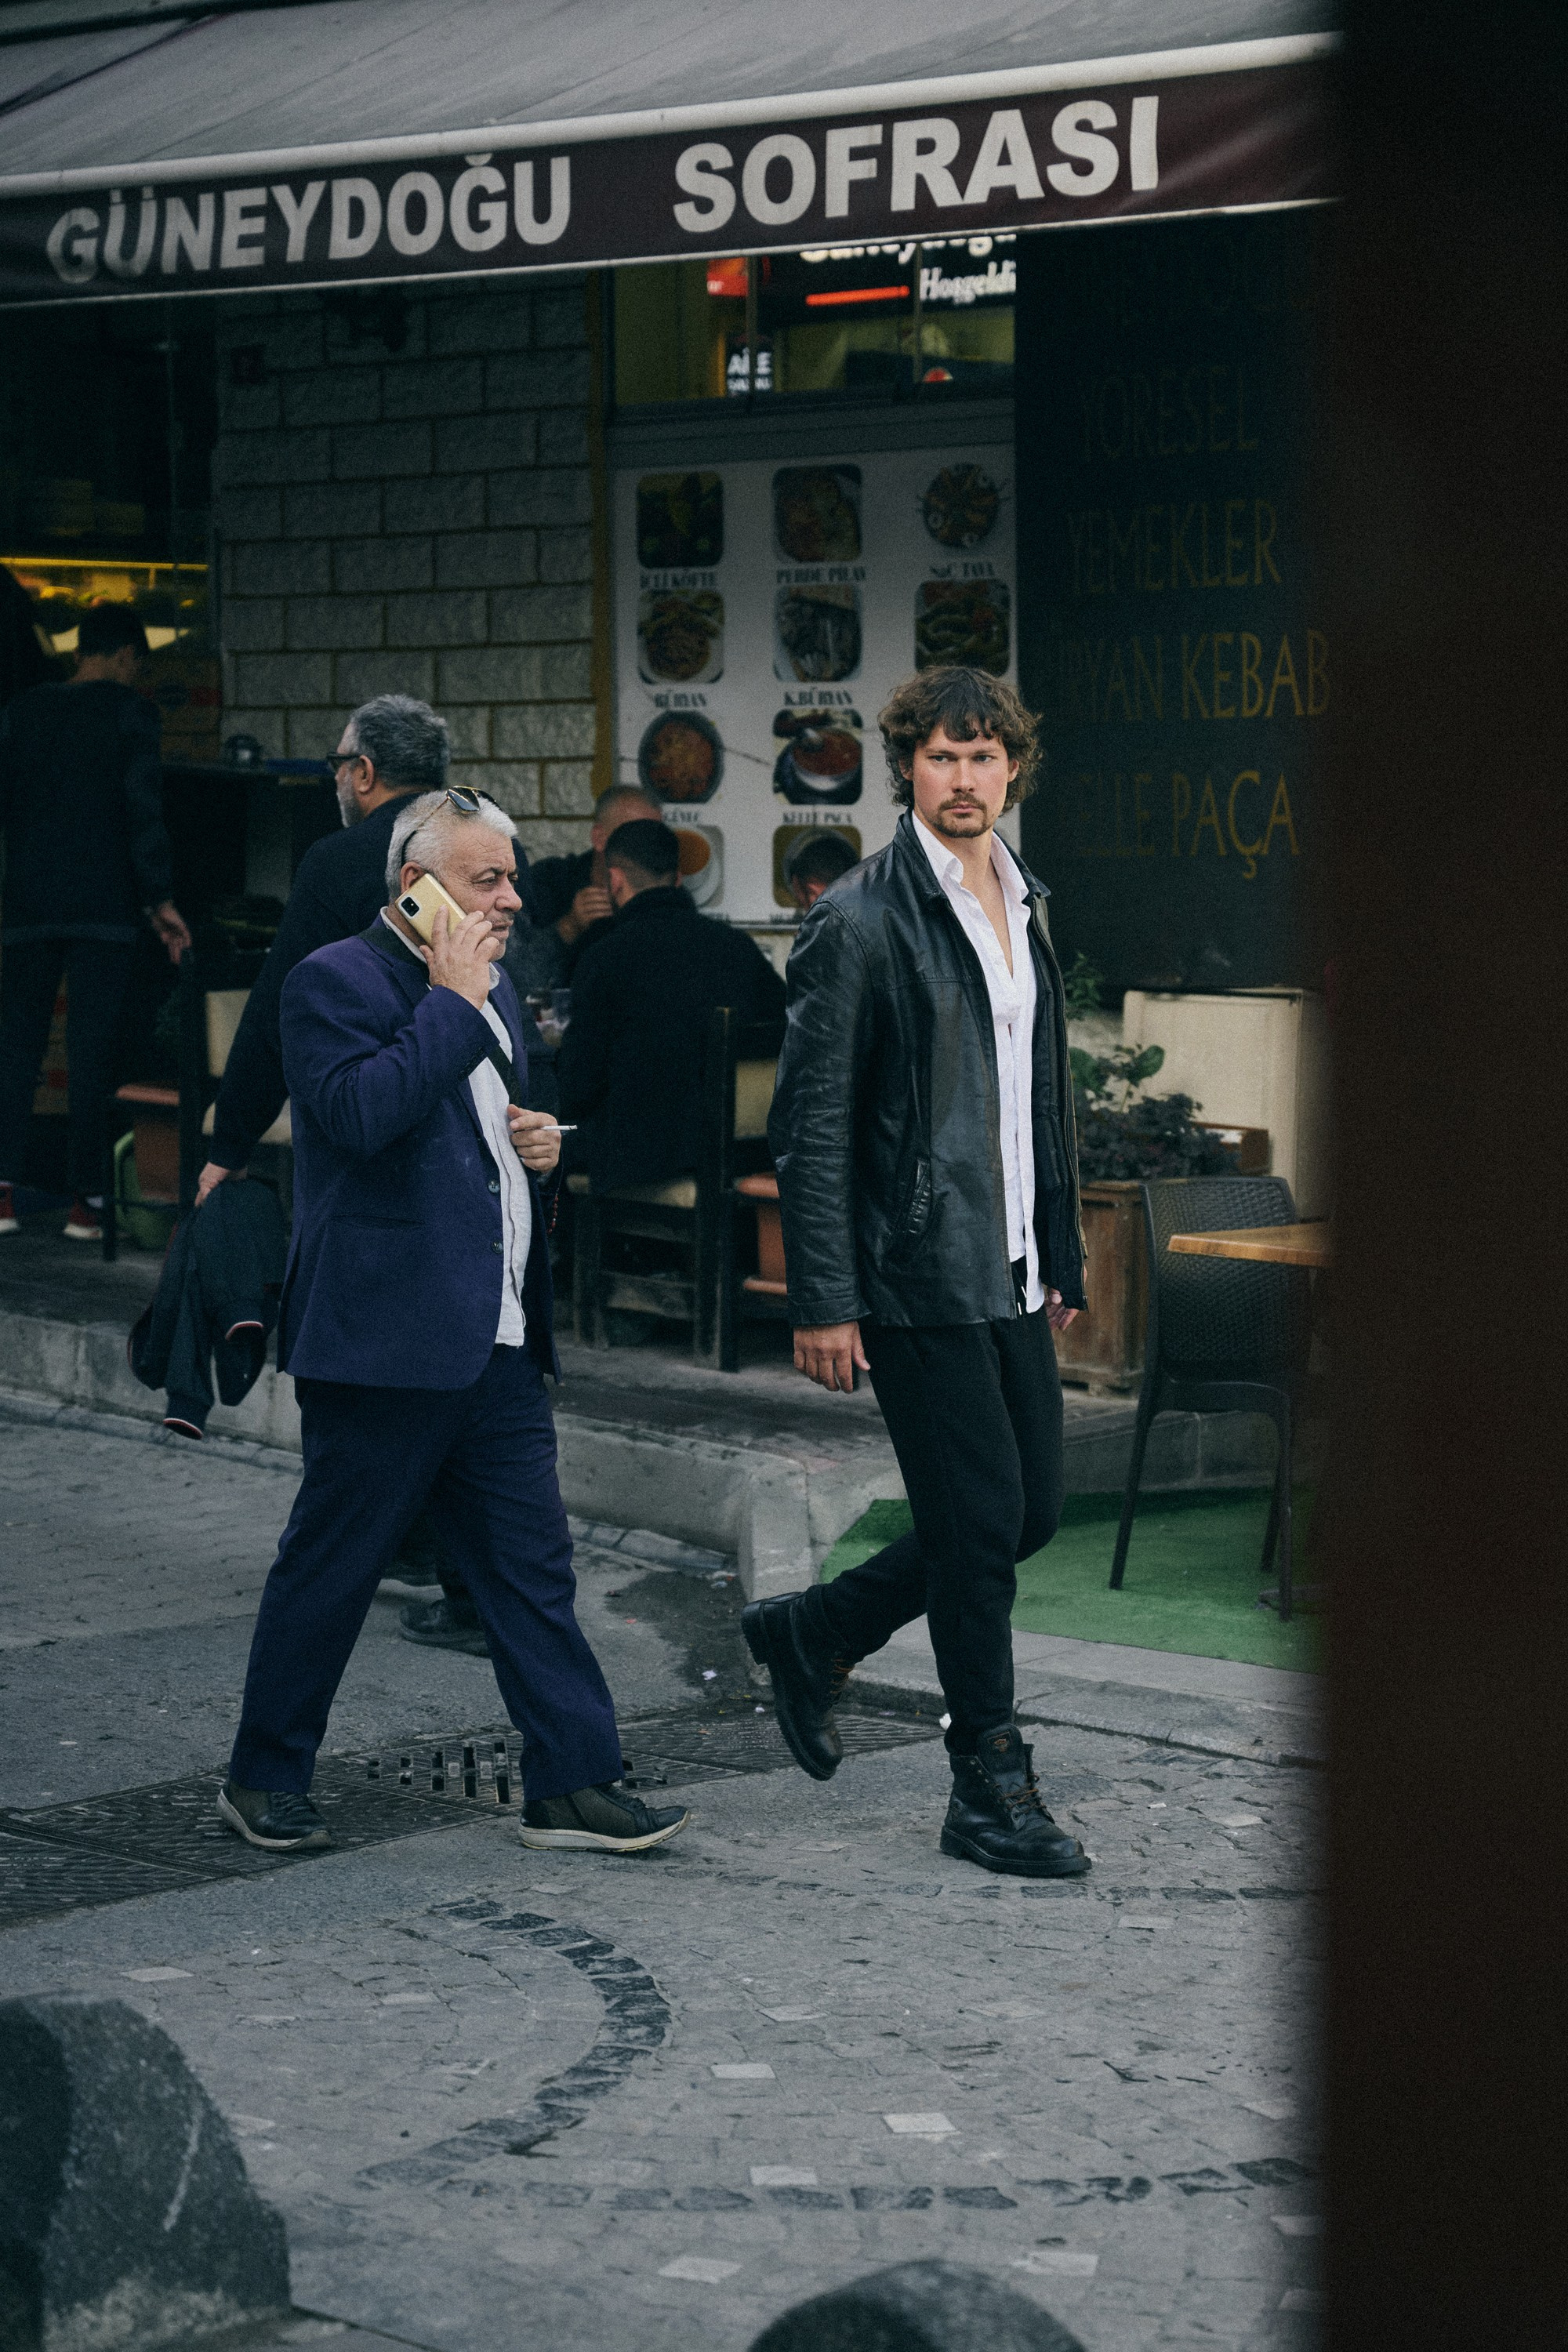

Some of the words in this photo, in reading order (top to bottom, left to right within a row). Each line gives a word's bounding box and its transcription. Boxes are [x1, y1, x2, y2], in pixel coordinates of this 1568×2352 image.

[47, 154, 572, 284] GÜNEYDOĞU
[673, 96, 1159, 233] SOFRASI
[1065, 497, 1283, 598] YEMEKLER
[1179, 626, 1330, 720] KEBAB
[1170, 768, 1301, 881] PAÇA
